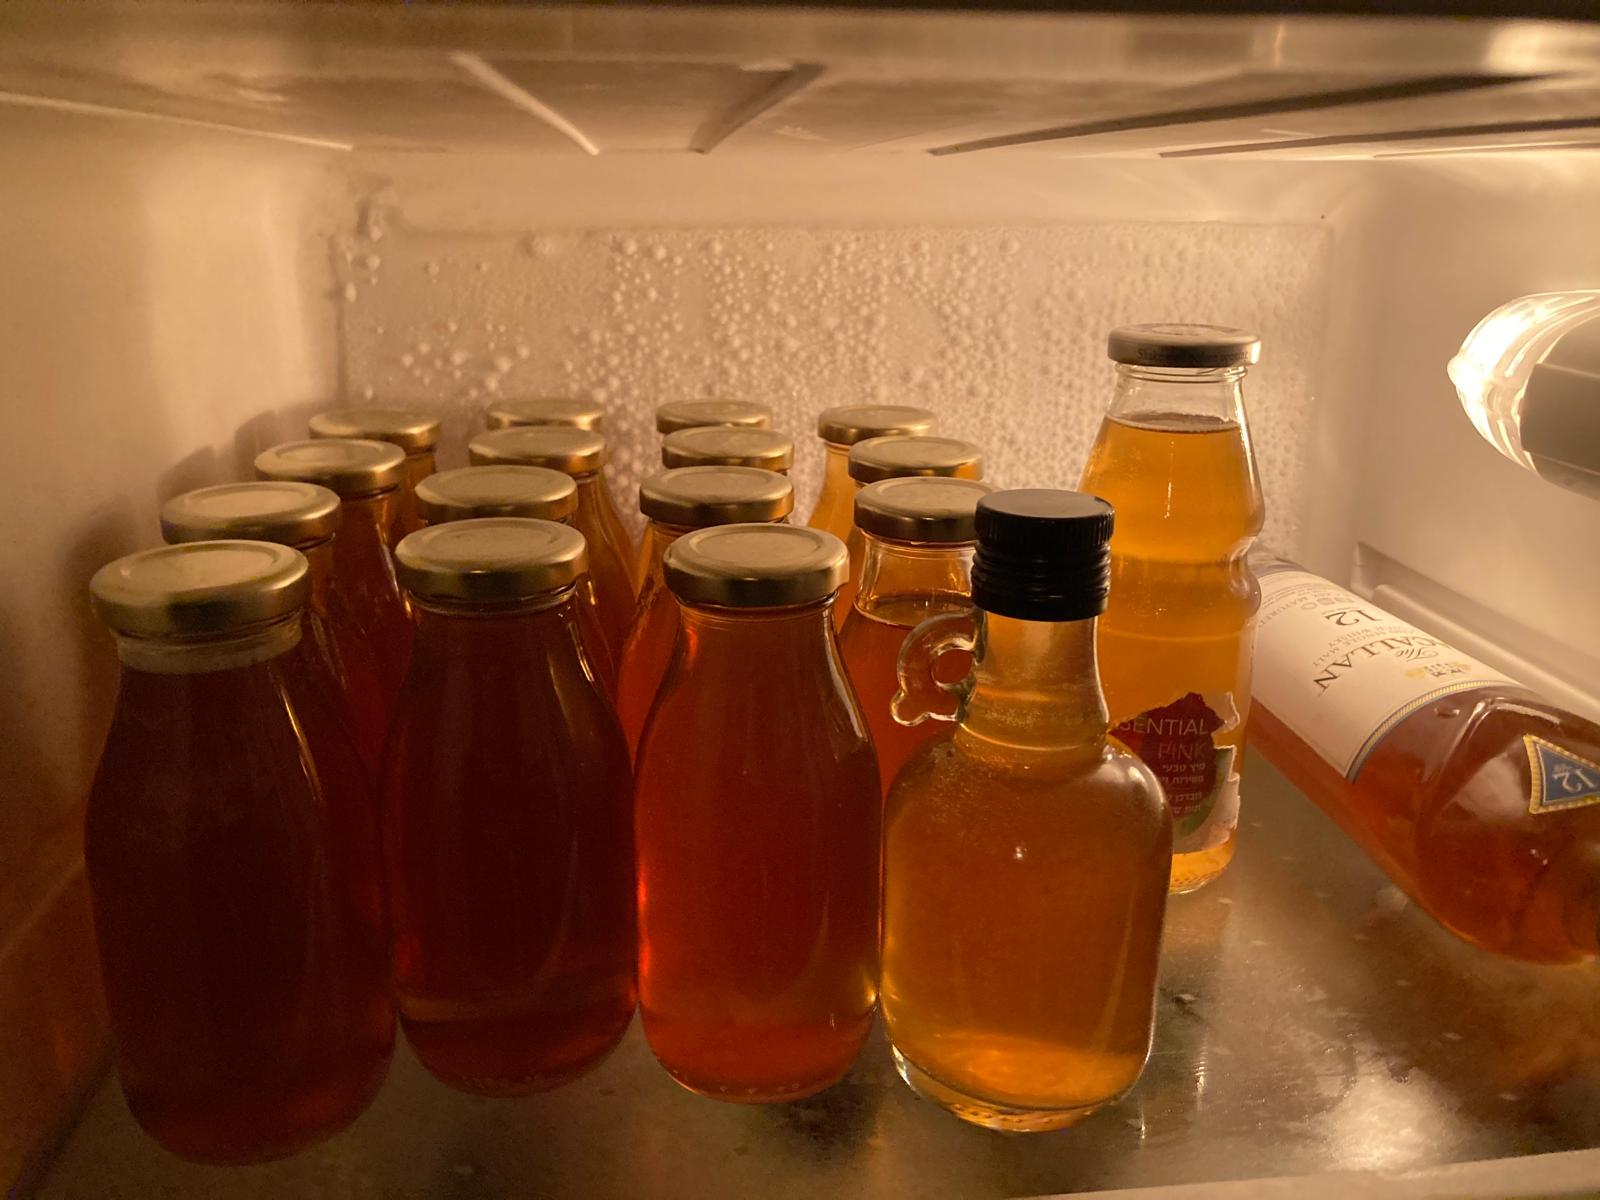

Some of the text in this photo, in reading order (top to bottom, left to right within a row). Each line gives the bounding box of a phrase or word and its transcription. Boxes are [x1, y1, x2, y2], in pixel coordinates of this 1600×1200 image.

[1325, 609, 1382, 626] 12
[1396, 647, 1439, 662] The
[1312, 634, 1440, 696] CALLAN
[1118, 717, 1208, 737] SENTIAL
[1158, 743, 1207, 761] PINK
[1552, 768, 1599, 794] 12
